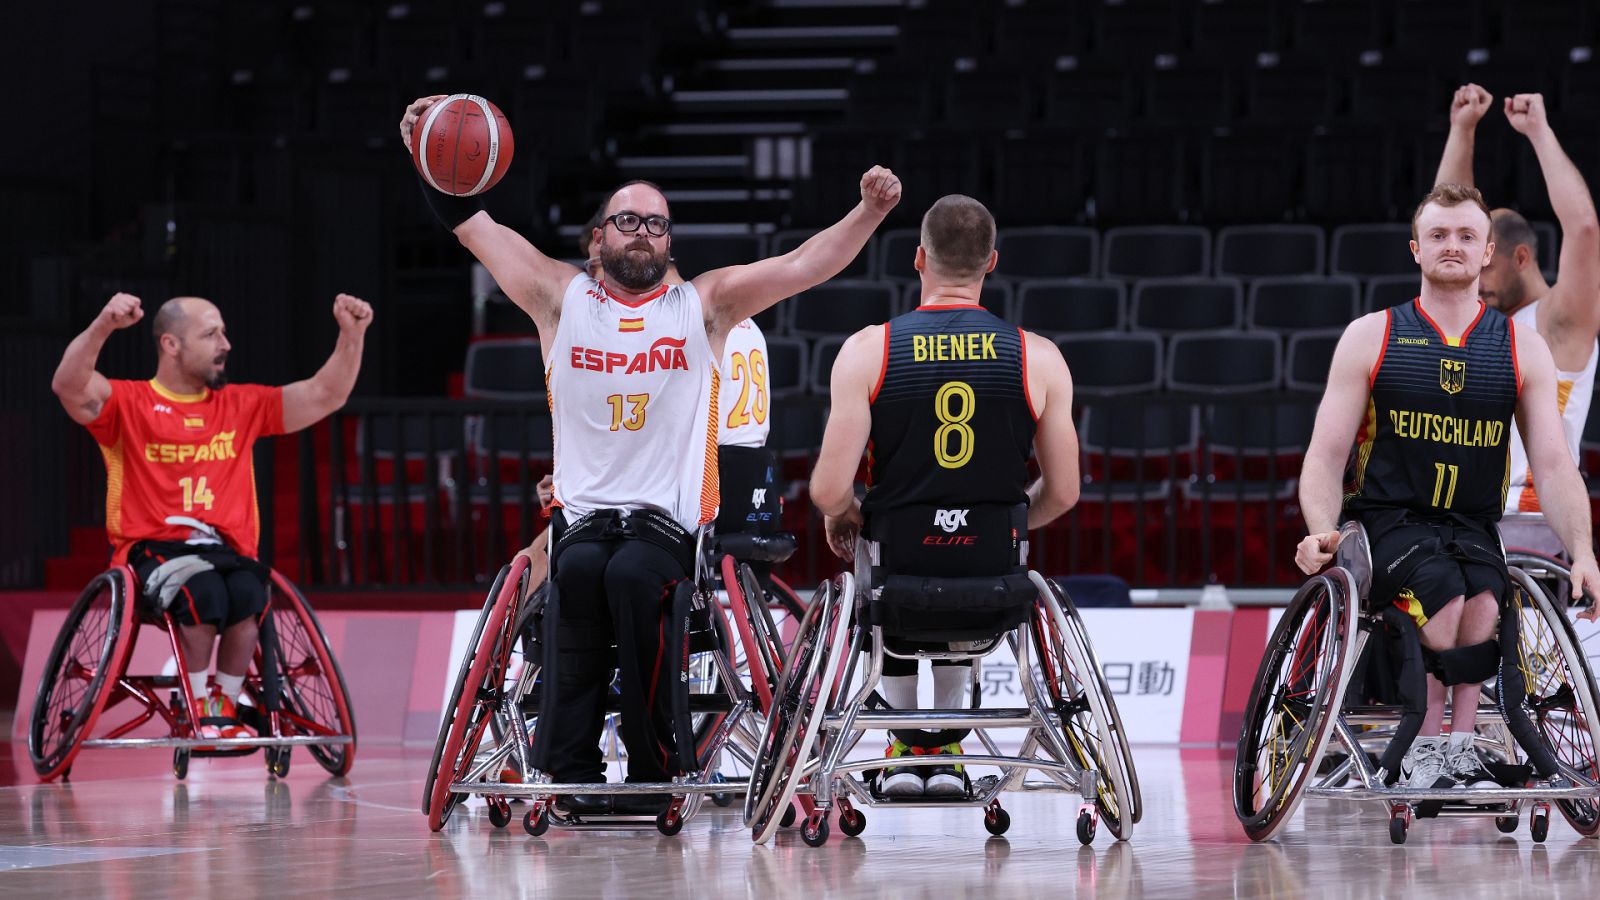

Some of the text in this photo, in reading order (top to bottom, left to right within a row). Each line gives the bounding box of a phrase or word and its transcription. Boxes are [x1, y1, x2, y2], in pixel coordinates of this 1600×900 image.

[571, 336, 689, 375] ESPAÑA
[913, 332, 997, 362] BIENEK
[1396, 337, 1429, 346] SPALDING
[727, 349, 768, 429] 28
[607, 392, 650, 432] 13
[934, 381, 976, 469] 8
[1389, 409, 1504, 448] DEUTSCHLAND
[178, 476, 215, 512] 14
[1431, 462, 1459, 510] 11
[923, 535, 978, 545] ELITE
